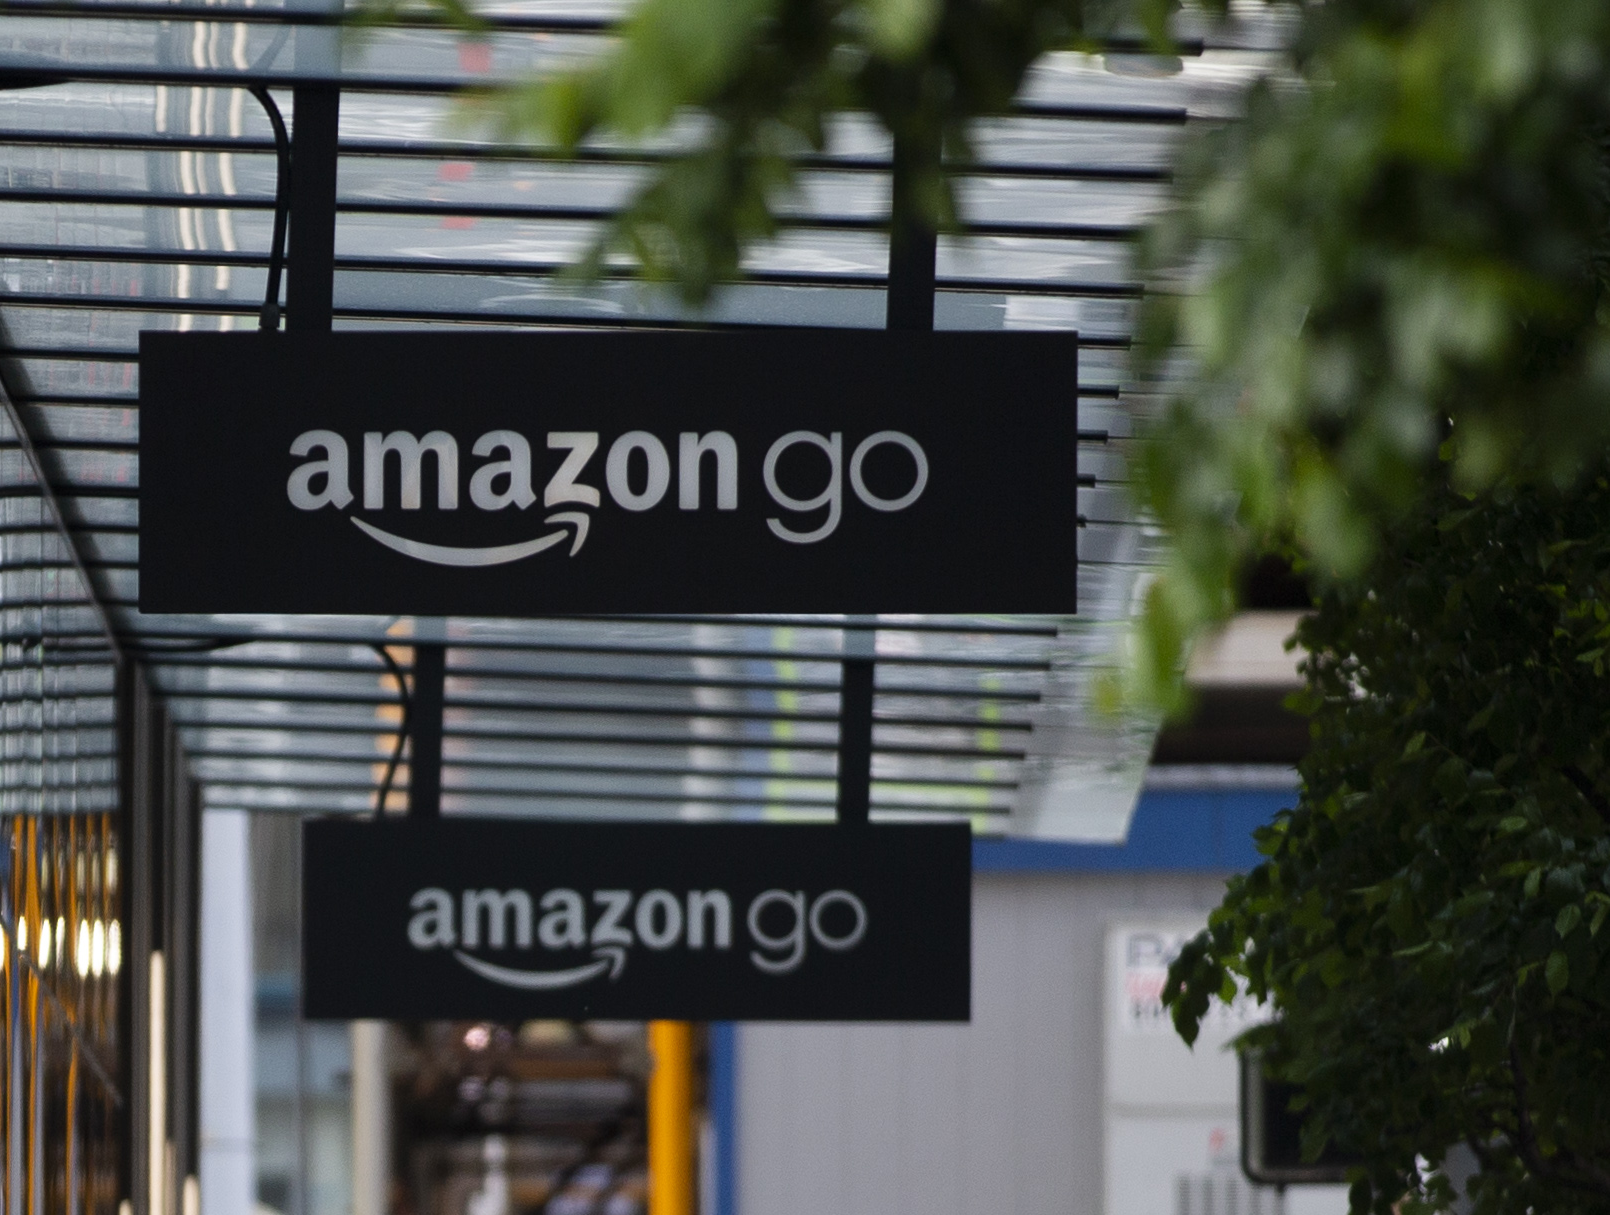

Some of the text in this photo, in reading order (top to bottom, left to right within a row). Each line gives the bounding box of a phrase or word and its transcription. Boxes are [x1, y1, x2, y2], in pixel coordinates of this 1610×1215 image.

[286, 428, 930, 545] amazon go
[407, 887, 868, 975] amazon go
